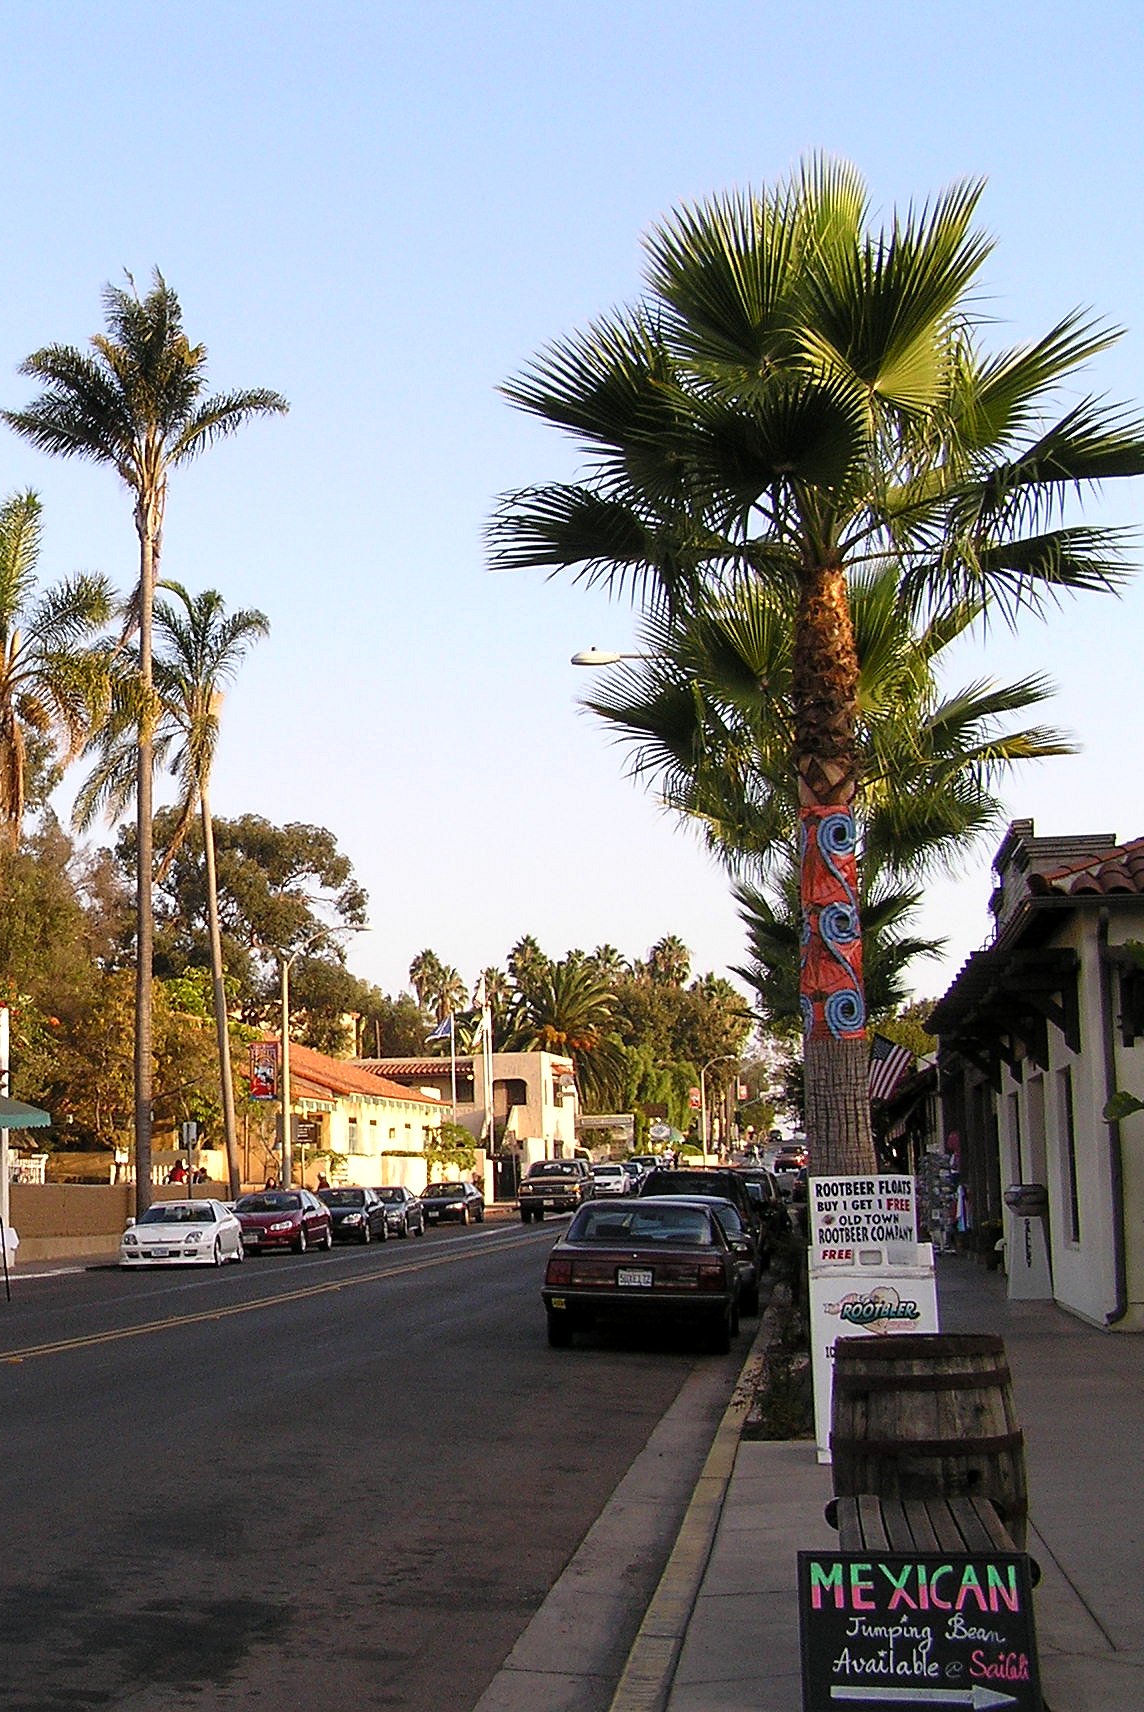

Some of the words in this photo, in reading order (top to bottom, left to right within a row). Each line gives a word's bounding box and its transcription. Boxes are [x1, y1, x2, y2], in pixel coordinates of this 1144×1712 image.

[815, 1181, 876, 1197] ROOTBEER
[878, 1180, 912, 1195] FLOATS
[817, 1201, 838, 1212] BUY
[842, 1201, 847, 1210] 1
[851, 1200, 873, 1210] GET
[877, 1200, 883, 1209] 1
[886, 1198, 911, 1211] FREE
[839, 1215, 862, 1226] OLD
[865, 1214, 899, 1224] TOWN
[819, 1227, 869, 1244] ROOTBEER
[870, 1226, 913, 1242] COMPANY
[822, 1249, 852, 1260] FREE
[810, 1562, 1019, 1612] MEXICAN
[845, 1613, 932, 1651] Jumping
[945, 1612, 1006, 1643] Bean
[832, 1647, 939, 1676] Available
